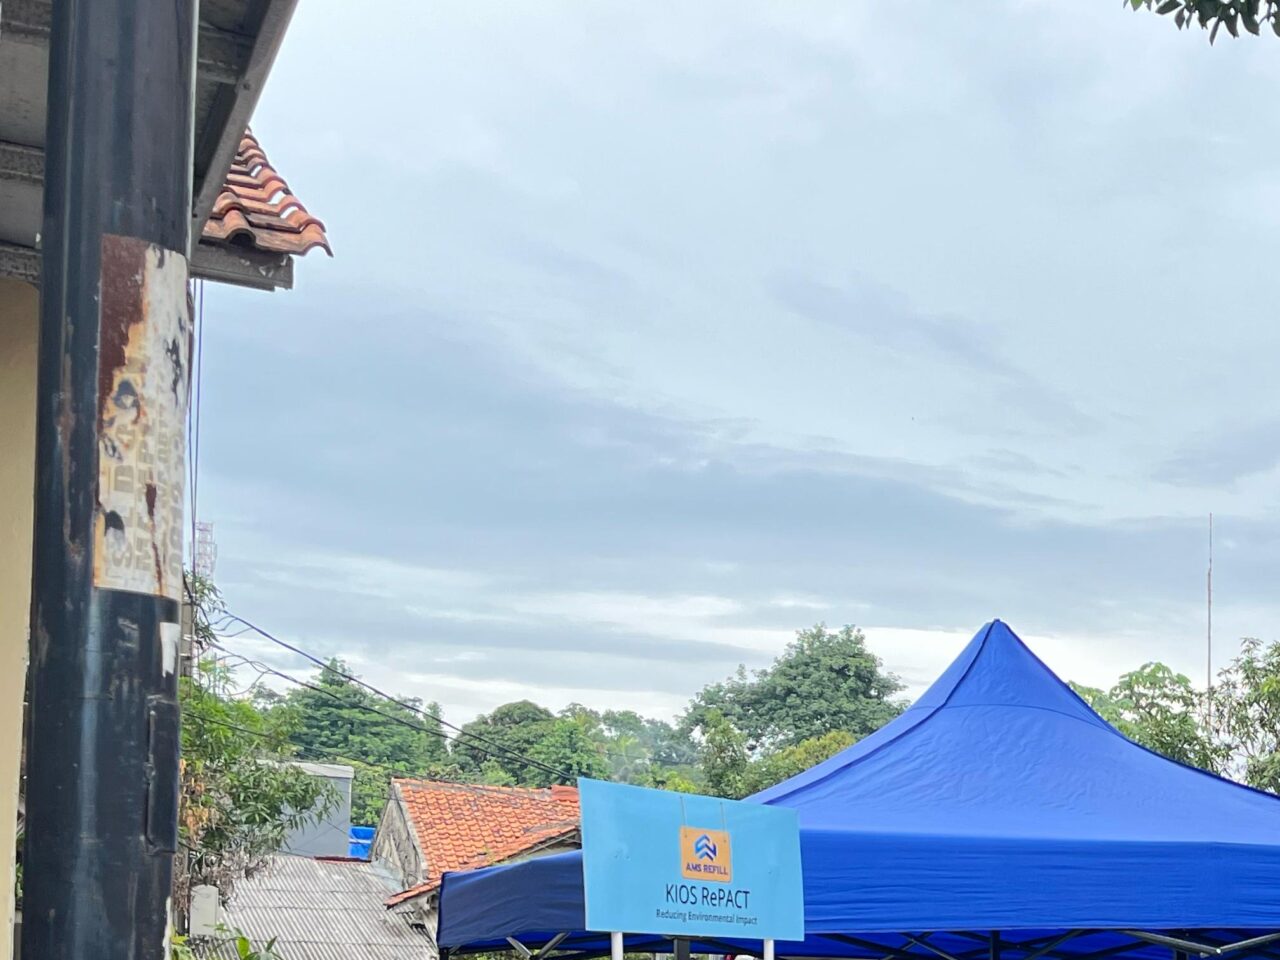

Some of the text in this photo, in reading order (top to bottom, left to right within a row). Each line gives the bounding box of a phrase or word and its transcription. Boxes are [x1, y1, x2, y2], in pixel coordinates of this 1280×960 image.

[686, 862, 729, 876] AMS REFILL
[666, 884, 750, 909] KIOS RePACT
[656, 909, 687, 923] Reducing
[688, 911, 735, 923] Environmental
